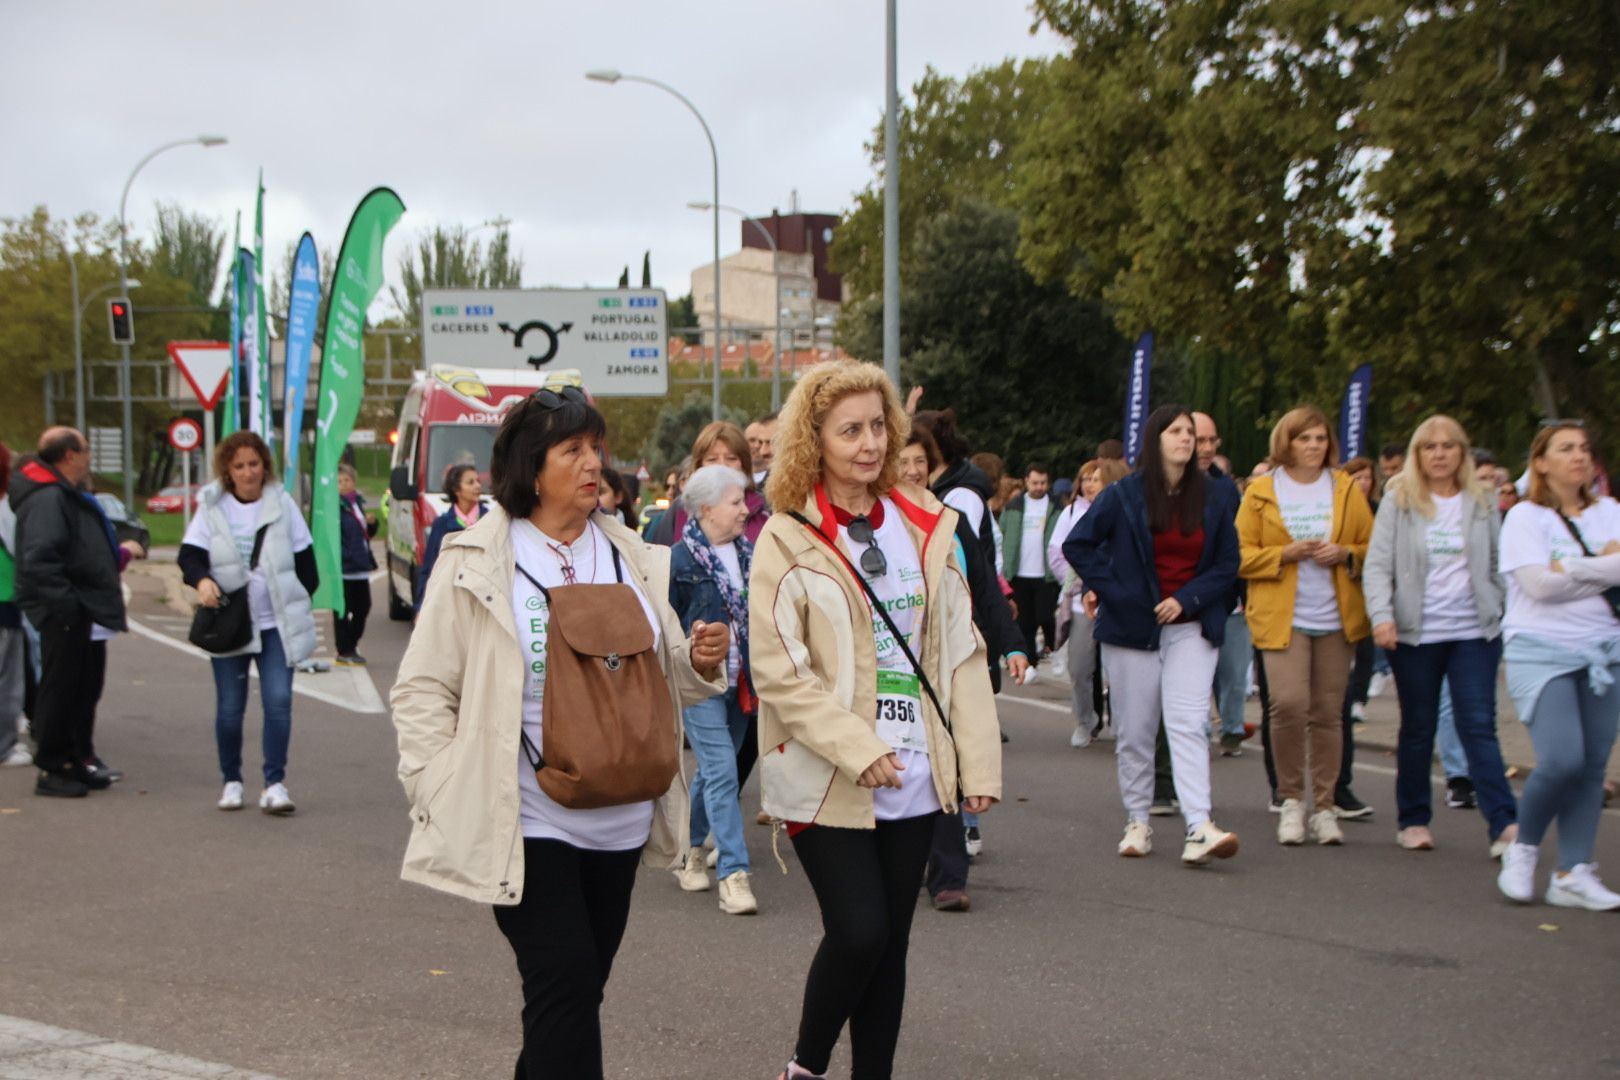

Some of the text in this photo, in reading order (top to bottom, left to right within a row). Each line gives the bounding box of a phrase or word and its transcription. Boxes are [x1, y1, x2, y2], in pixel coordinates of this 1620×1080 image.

[591, 314, 656, 324] PORTUGAL
[431, 322, 489, 333] CACERES
[584, 331, 659, 342] VALLADOLID
[606, 364, 658, 376] ZAMORA
